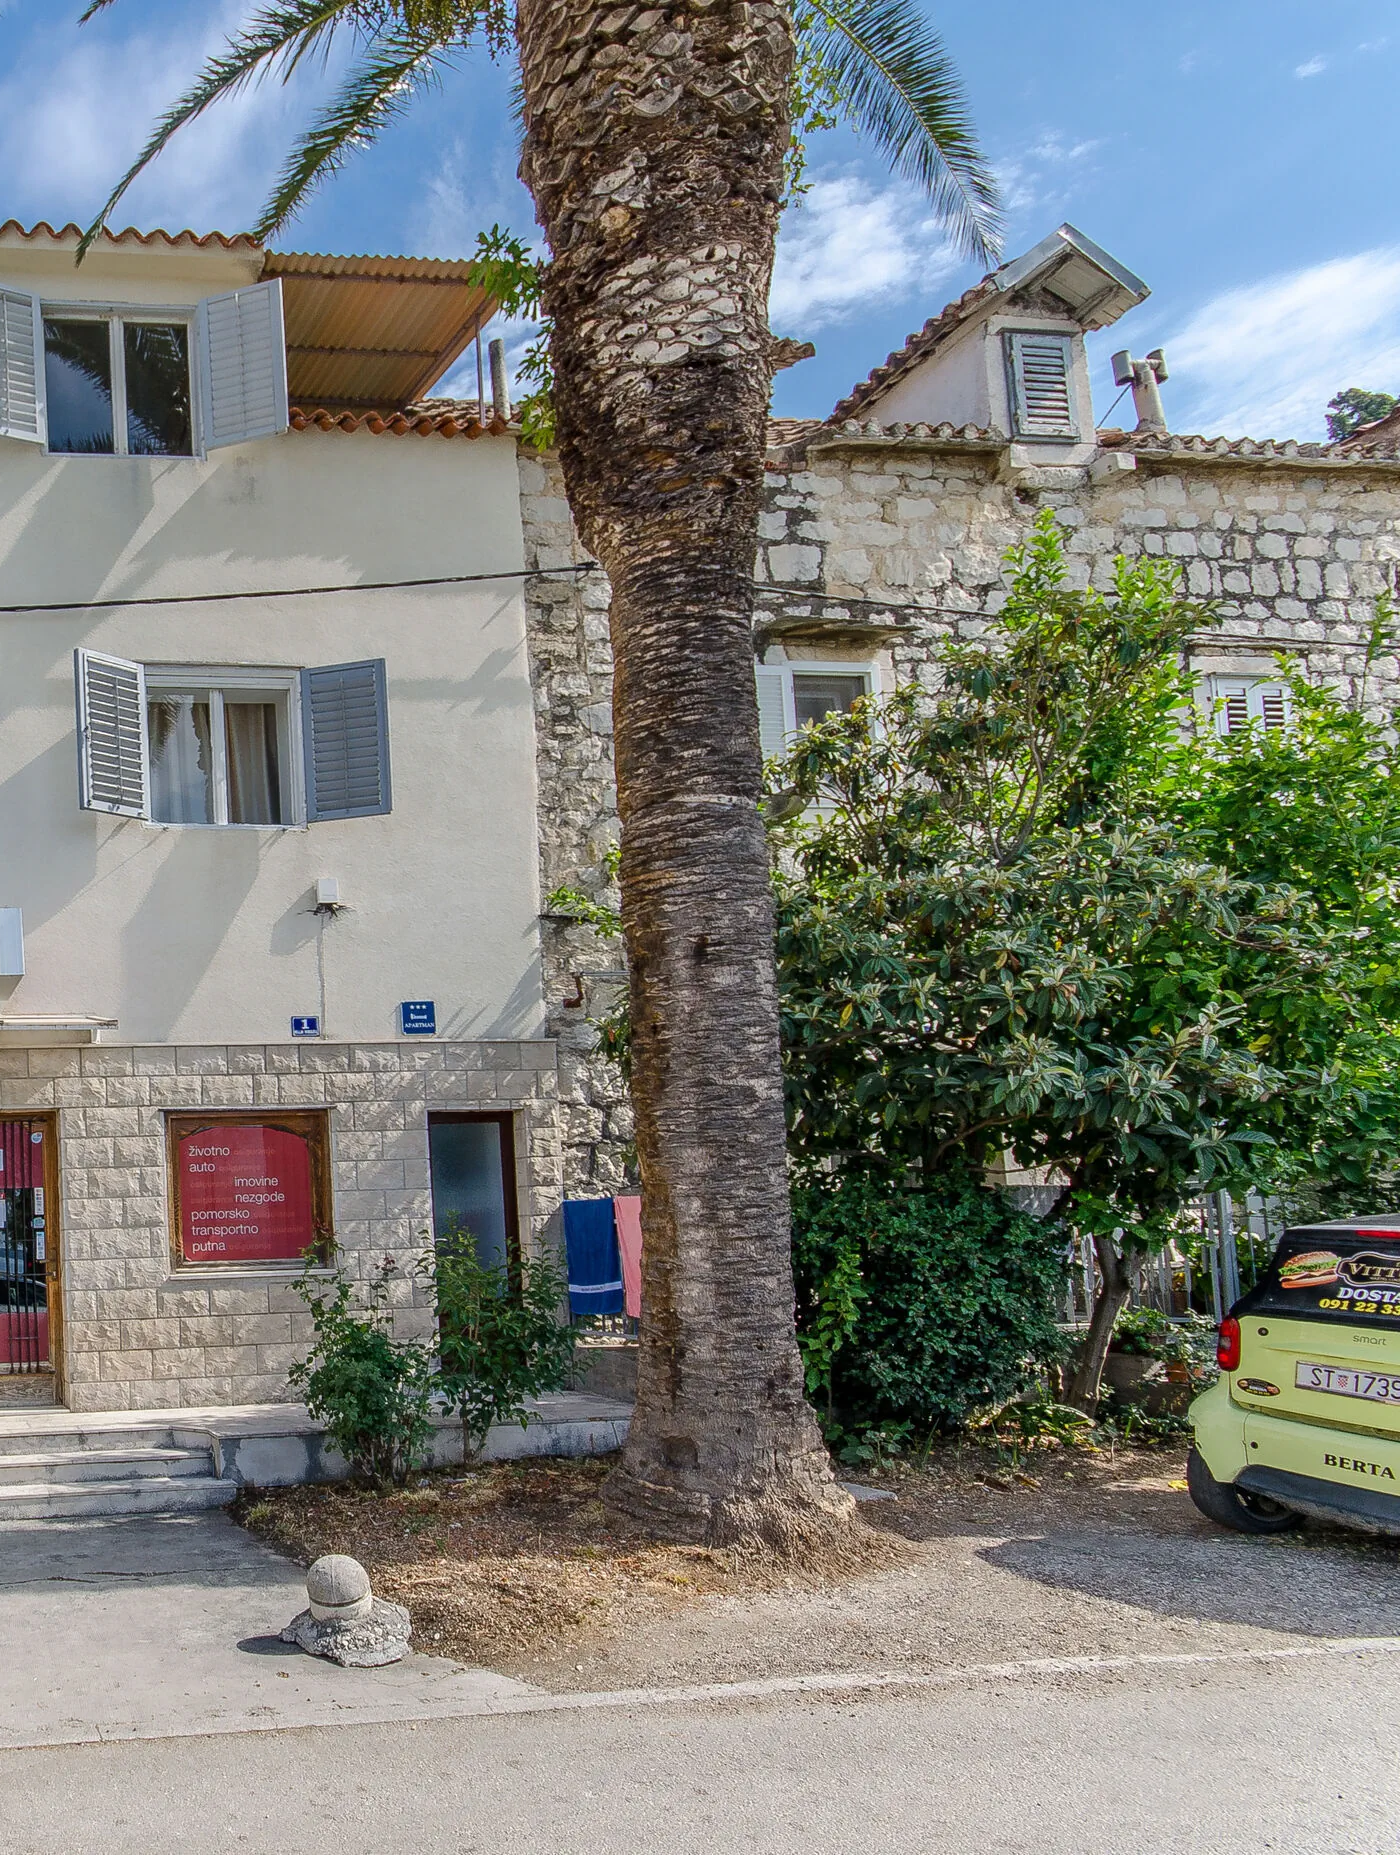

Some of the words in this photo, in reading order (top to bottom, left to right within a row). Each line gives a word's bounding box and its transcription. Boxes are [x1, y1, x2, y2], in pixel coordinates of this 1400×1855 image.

[301, 1019, 310, 1029] 1
[188, 1145, 230, 1157] životno
[189, 1162, 216, 1173] auto
[234, 1176, 279, 1187] imovine
[235, 1191, 285, 1205] nezgode
[191, 1208, 250, 1222] pomorsko
[191, 1224, 259, 1237] transportno
[192, 1241, 226, 1254] putna
[1348, 1262, 1400, 1278] VITT
[1319, 1299, 1349, 1311] 091
[1353, 1302, 1377, 1313] 22
[1352, 1335, 1387, 1346] smart
[1311, 1368, 1335, 1388] ST
[1323, 1453, 1396, 1480] BERTA
